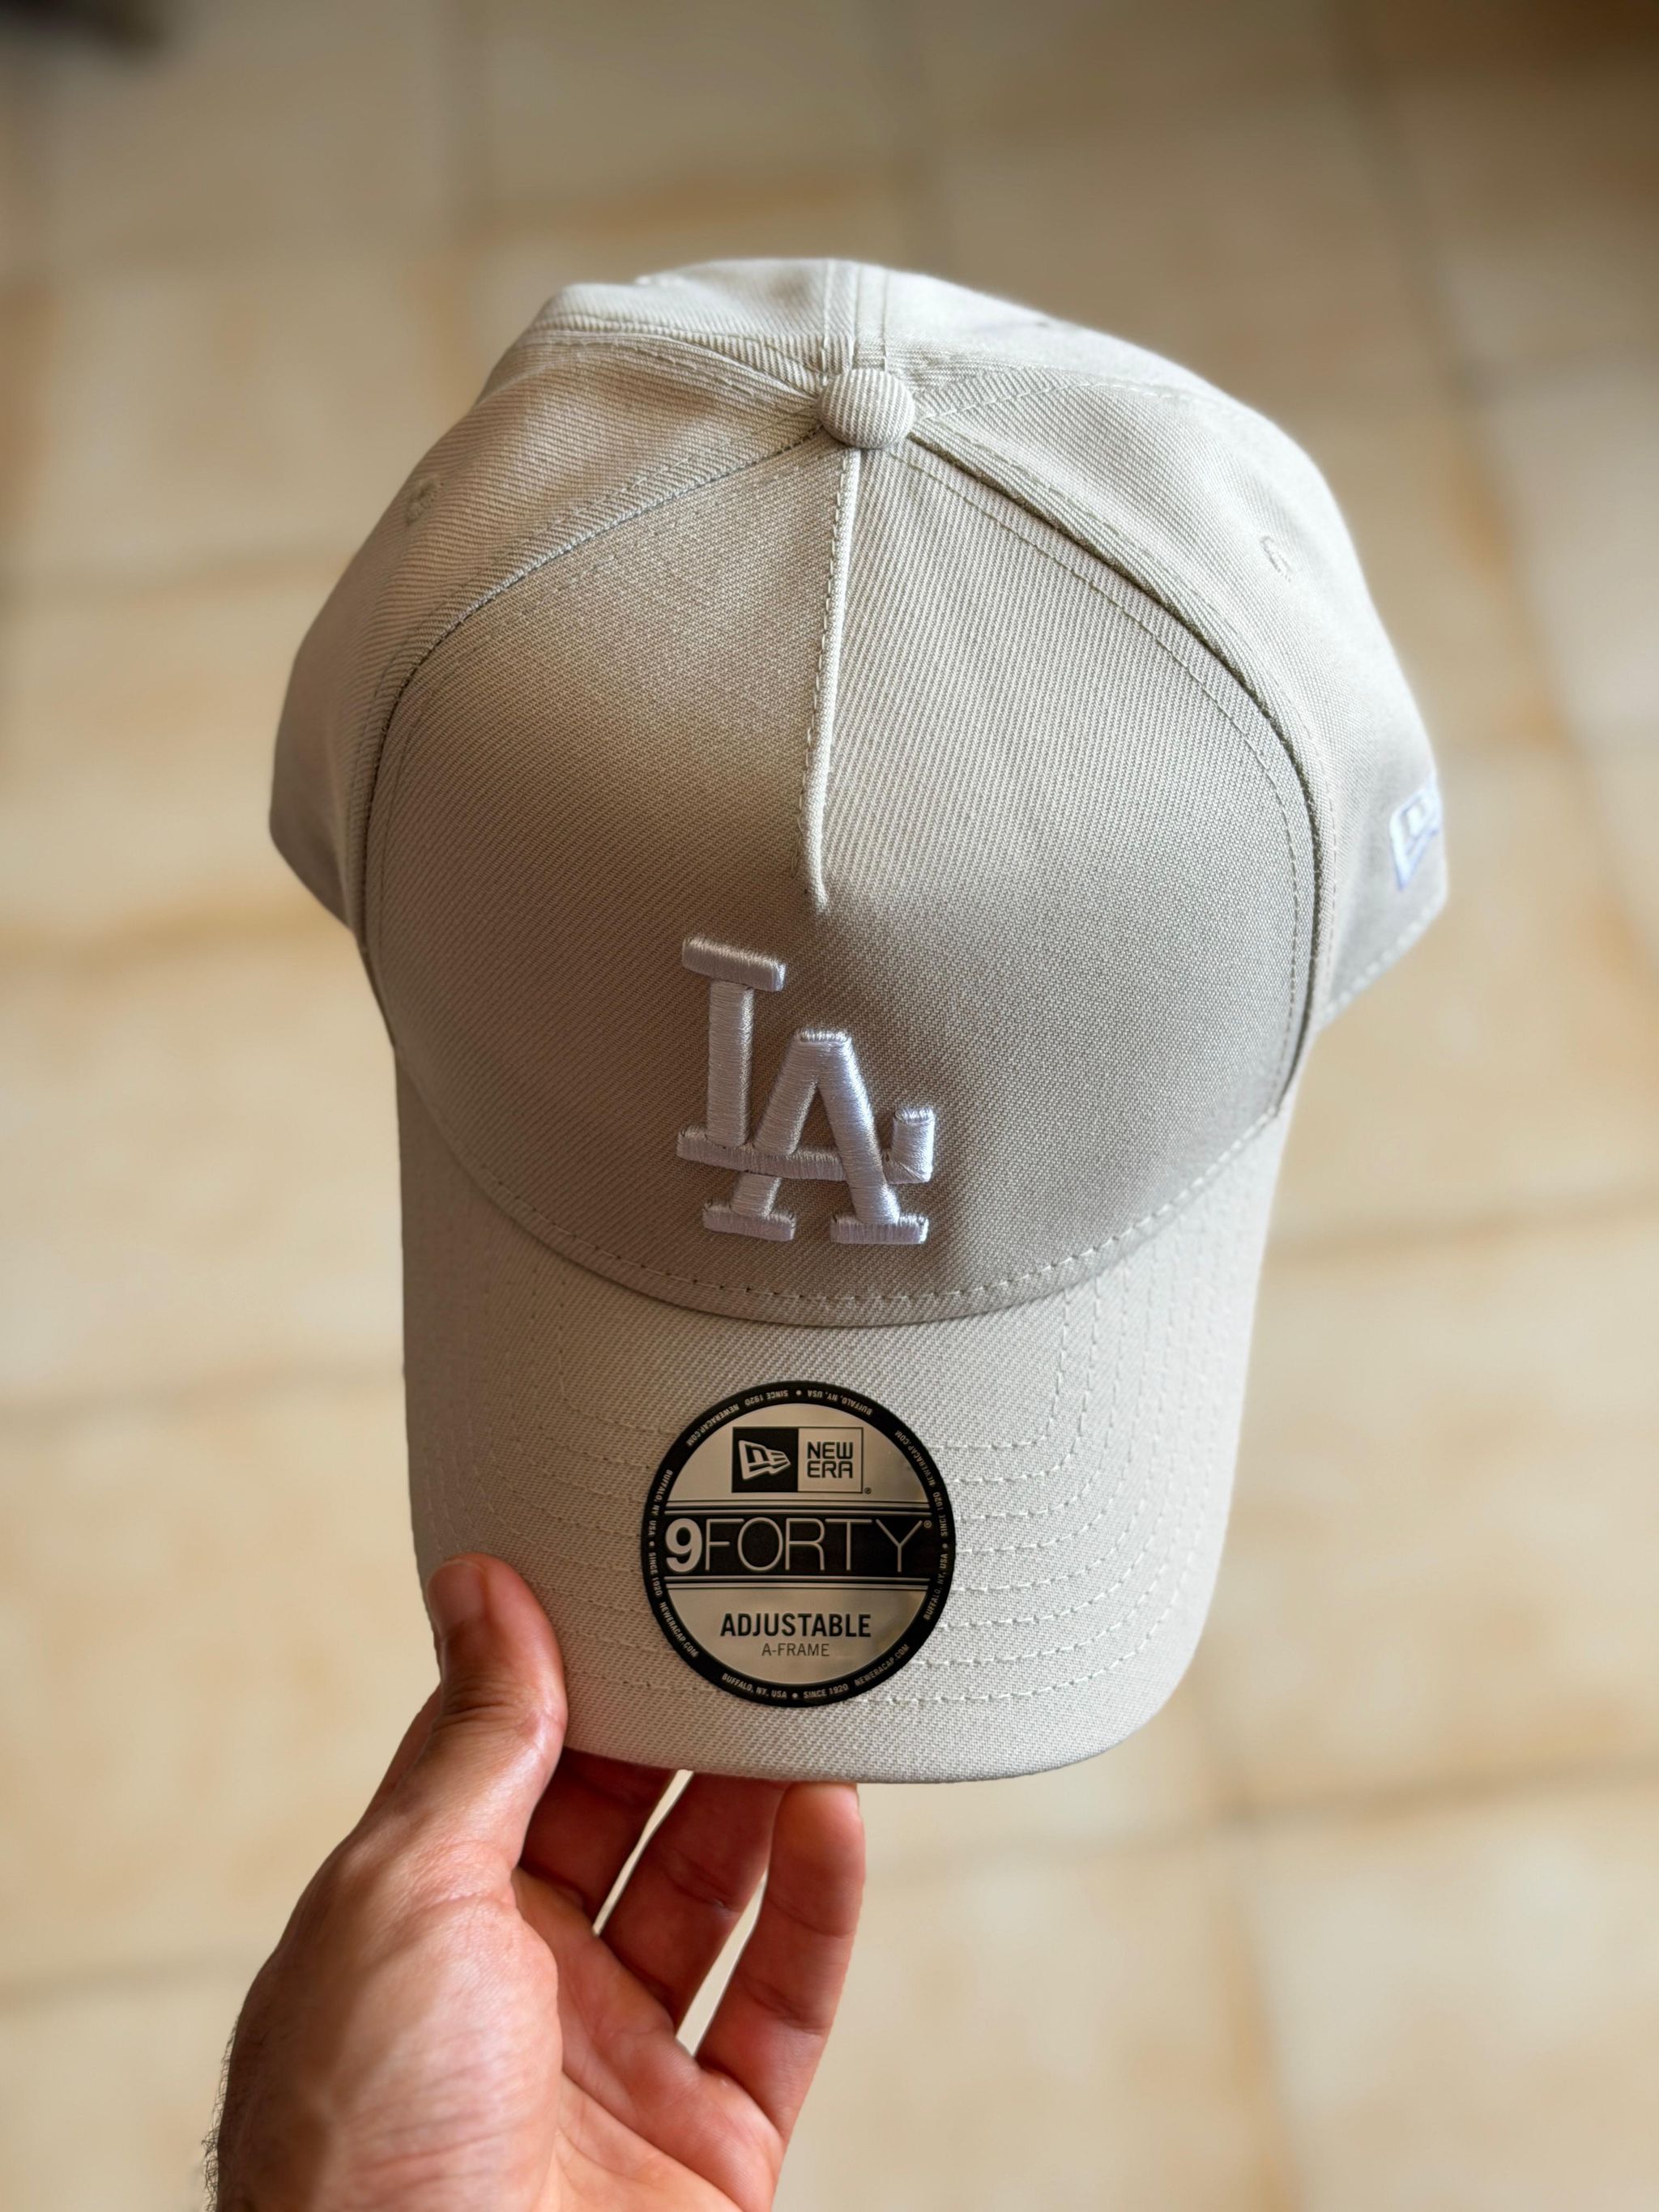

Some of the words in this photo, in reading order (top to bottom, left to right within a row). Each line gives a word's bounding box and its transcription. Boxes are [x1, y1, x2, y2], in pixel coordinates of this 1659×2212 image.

[677, 934, 936, 1245] LA
[744, 1394, 764, 1406] 1920
[766, 1390, 789, 1400] SINCE
[808, 1390, 823, 1398] USA
[807, 1441, 853, 1460] NEW
[807, 1460, 853, 1479] ERA
[648, 1519, 657, 1536] USA
[938, 1515, 949, 1536] SINCE
[649, 1552, 659, 1575] SINCE
[940, 1554, 949, 1569] USA
[719, 1613, 872, 1638] ADJUSTABLE
[761, 1643, 830, 1657] A-FRAME
[771, 1690, 787, 1698] USA
[803, 1689, 828, 1698] SINCE
[829, 1683, 850, 1694] 1920
[854, 1643, 910, 1686] NEWERACAP.COM
